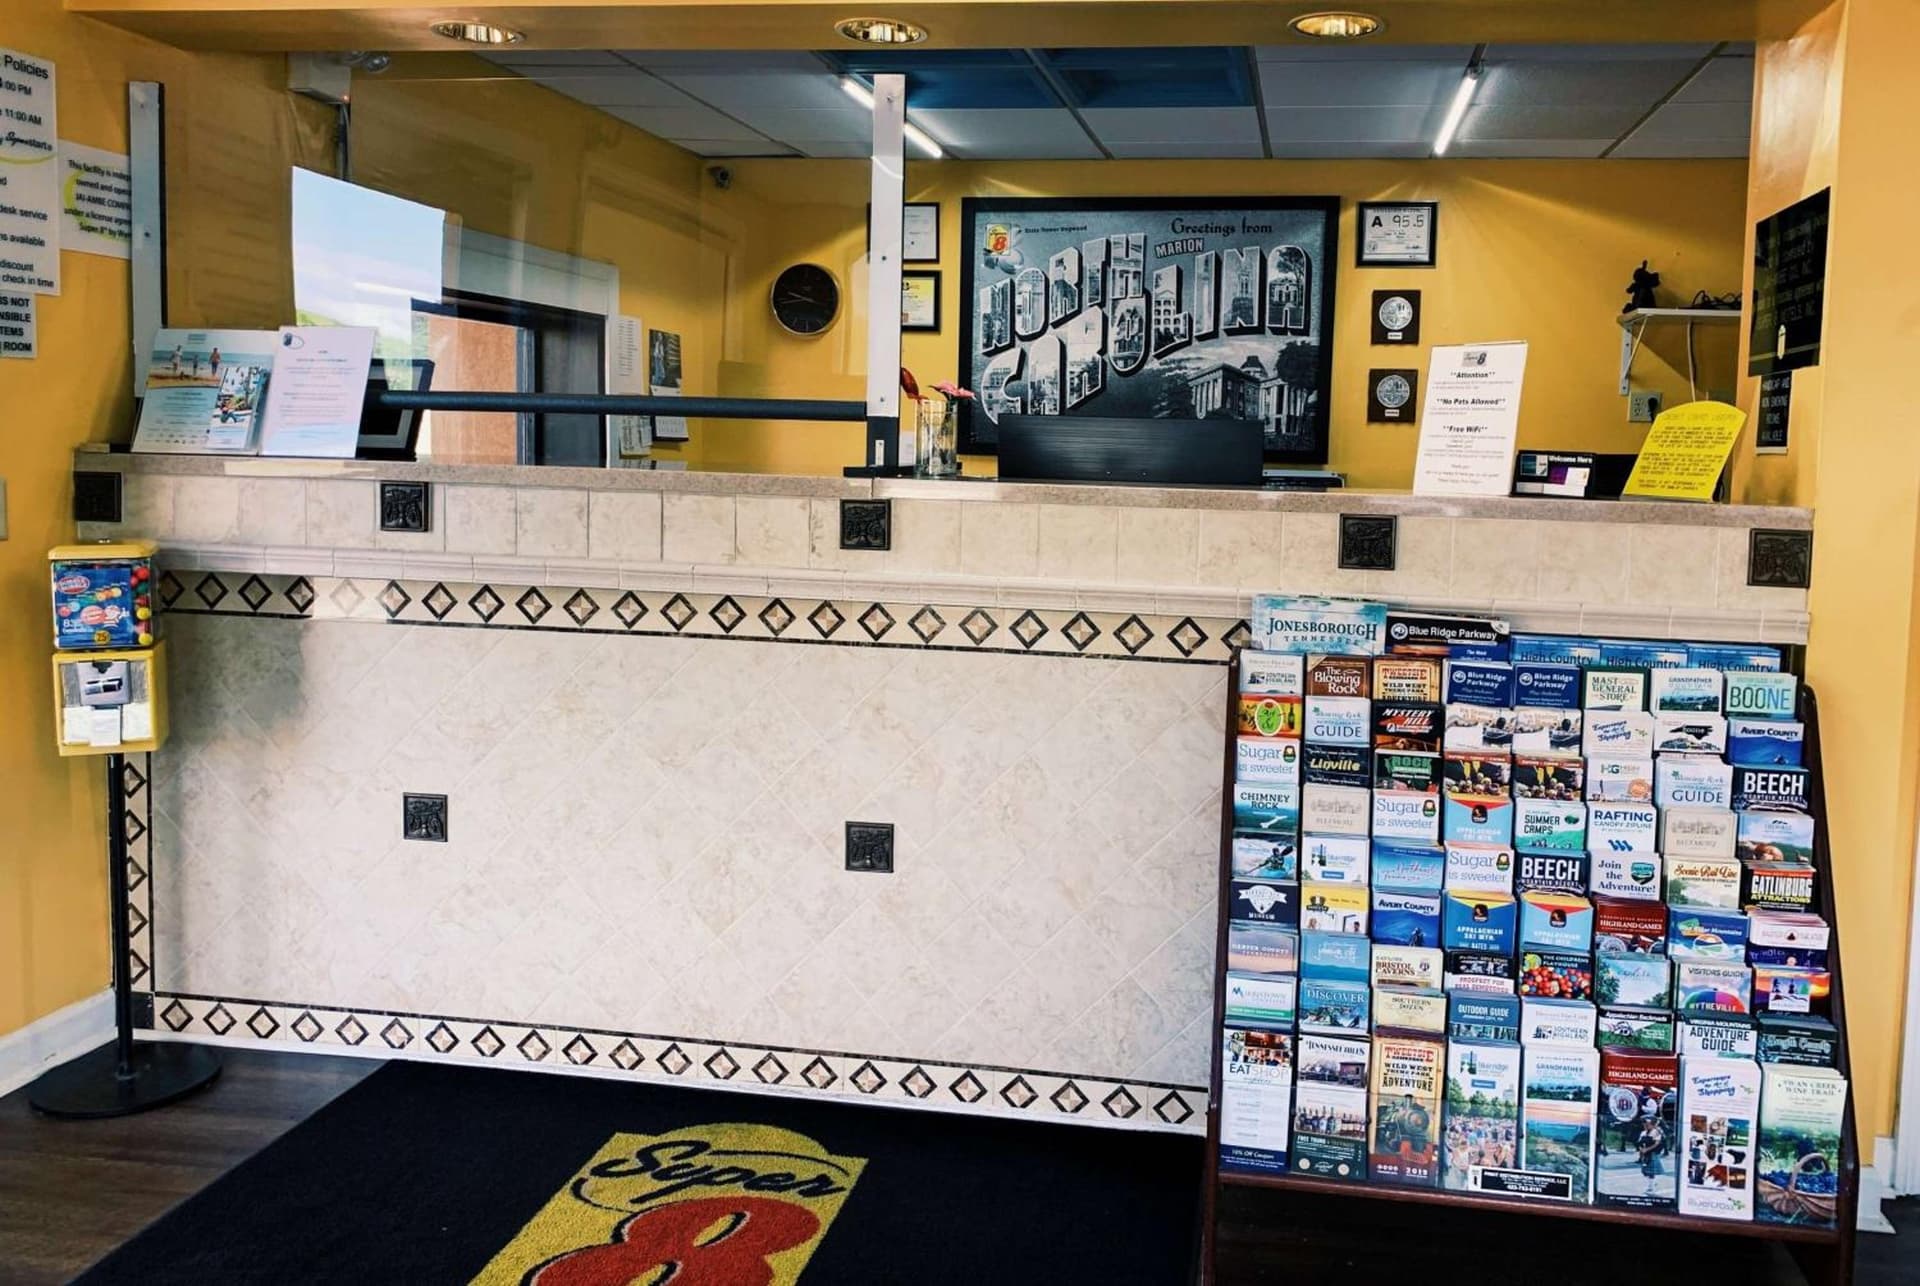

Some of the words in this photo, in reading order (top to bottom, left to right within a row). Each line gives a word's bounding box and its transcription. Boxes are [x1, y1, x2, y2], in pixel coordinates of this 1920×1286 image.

[4, 55, 49, 79] Policies
[28, 114, 42, 126] AM
[20, 207, 48, 221] service
[1171, 217, 1236, 237] Greetings
[1241, 215, 1272, 234] from
[1371, 215, 1383, 228] A
[10, 233, 46, 247] available
[1155, 239, 1204, 257] MARION
[2, 273, 26, 285] check
[38, 277, 54, 288] time
[980, 233, 1148, 356] NORTH
[10, 297, 30, 308] NOT
[980, 245, 1313, 424] CAROLINA
[3, 341, 32, 352] ROOM
[1266, 618, 1377, 641] JONESBOROUGH
[1408, 626, 1429, 636] Blue
[1430, 626, 1458, 639] Ridge
[1459, 628, 1498, 641] Parkway
[1521, 651, 1546, 663] High
[1549, 652, 1593, 665] Country
[1635, 656, 1681, 669] Country
[1326, 666, 1341, 675] The
[1727, 661, 1774, 672] Country
[1314, 672, 1360, 687] Blowing
[1467, 671, 1485, 680] Blue
[1486, 673, 1507, 683] Ridge
[1534, 672, 1551, 681] Blue
[1552, 673, 1574, 683] Ridge
[1592, 676, 1618, 684] MAST
[1328, 683, 1358, 694] Rock
[1466, 679, 1499, 690] Parkway
[1533, 680, 1567, 690] Parkway
[1592, 683, 1637, 694] GENERAL
[1599, 693, 1629, 703] STORE
[1729, 686, 1792, 710] BOONE
[1382, 708, 1434, 717] MYSTERY
[1313, 725, 1362, 737] GUIDE
[1766, 727, 1799, 737] COUNTY
[1239, 744, 1282, 761] Sugar
[1238, 763, 1248, 772] is
[1310, 758, 1361, 772] Linville
[1391, 756, 1432, 768] ROCK
[1744, 771, 1805, 796] BEECH
[1240, 792, 1290, 803] CHIMNEY
[1672, 790, 1724, 803] GUIDE
[1251, 800, 1279, 810] ROCK
[1376, 798, 1421, 816] Sugar
[1375, 817, 1386, 826] is
[1524, 814, 1561, 826] SUMMER
[1594, 810, 1654, 822] RAFTING
[1523, 824, 1554, 836] CAMPS
[1448, 851, 1497, 869] Sugar
[1598, 860, 1622, 870] Join
[1521, 857, 1580, 881] BEECH
[1448, 871, 1458, 880] is
[1605, 871, 1623, 880] the
[1598, 880, 1656, 893] Adventure!
[1752, 875, 1813, 898] GATLINBURG
[1750, 894, 1811, 904] ATTRACTIONS
[1404, 901, 1434, 912] COUNTY
[1456, 926, 1503, 935] APPALACHIAN
[1599, 919, 1637, 929] HIGHLAND
[1638, 922, 1663, 930] GAMES
[1375, 961, 1412, 970] BRISTOL
[1375, 968, 1416, 976] CAVERNS
[1688, 967, 1721, 977] VISITORS
[1722, 969, 1745, 978] GUIDE
[1307, 989, 1365, 1003] DISCOVER
[1457, 1004, 1488, 1014] OUTDOOR
[1489, 1006, 1510, 1017] GUIDE
[1690, 1026, 1750, 1042] ADVENTURE
[1701, 1037, 1737, 1051] GUIDE
[1384, 1062, 1408, 1070] WILD
[1409, 1064, 1432, 1072] WEST
[1535, 1063, 1584, 1072] GRANDFATHER
[1607, 1071, 1648, 1080] HIGHLAND
[1648, 1073, 1674, 1081] GAMES
[1382, 1076, 1433, 1092] ADVENTURE
[1811, 1082, 1838, 1090] CREEK
[1697, 1087, 1736, 1097] Shopping
[590, 1139, 846, 1205] Super
